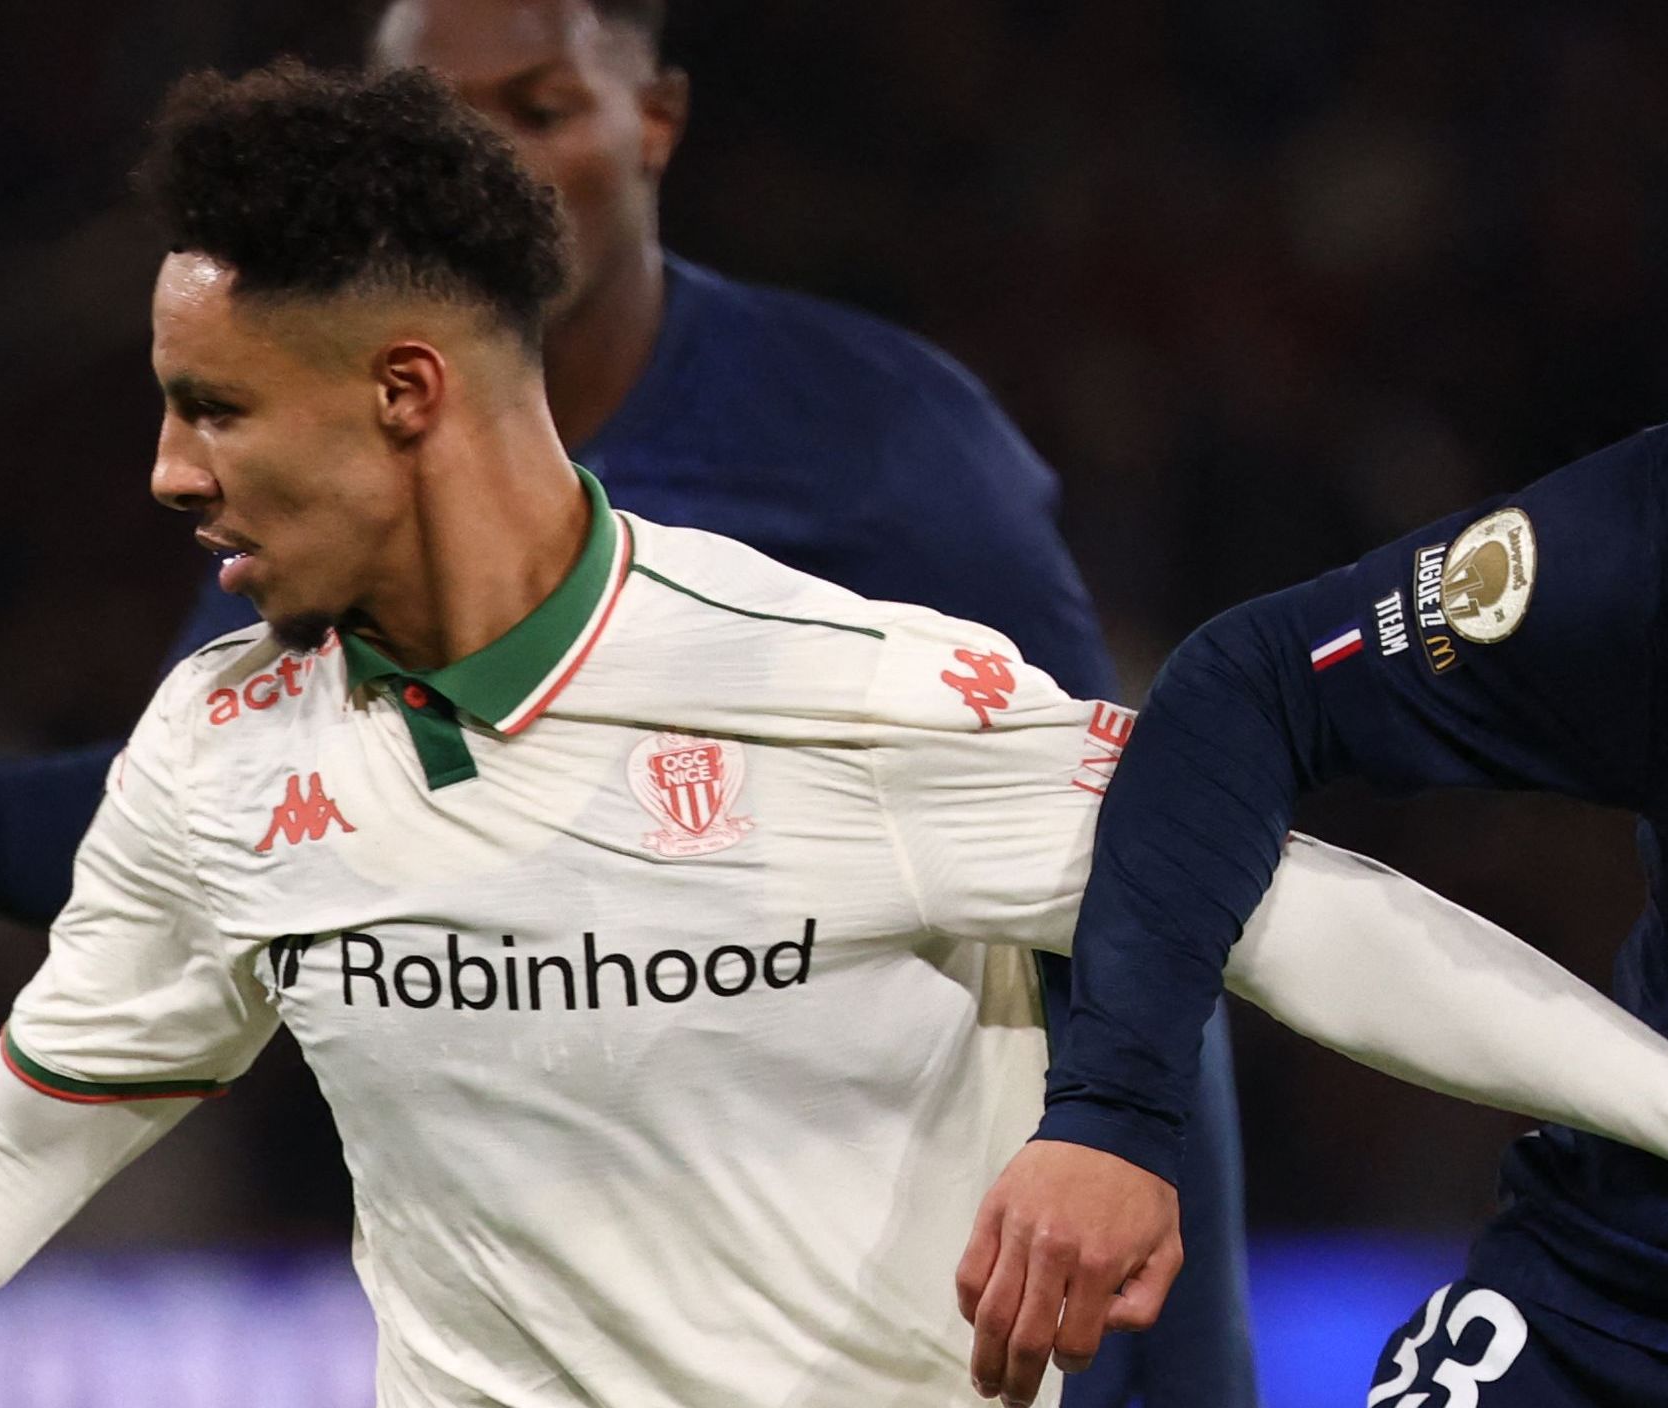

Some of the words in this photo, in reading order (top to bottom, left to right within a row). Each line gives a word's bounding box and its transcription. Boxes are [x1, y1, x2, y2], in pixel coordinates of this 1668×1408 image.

[1417, 545, 1447, 611] LIGUE
[661, 749, 709, 771] OGC
[664, 765, 713, 786] NICE
[340, 917, 817, 1011] Robinhood
